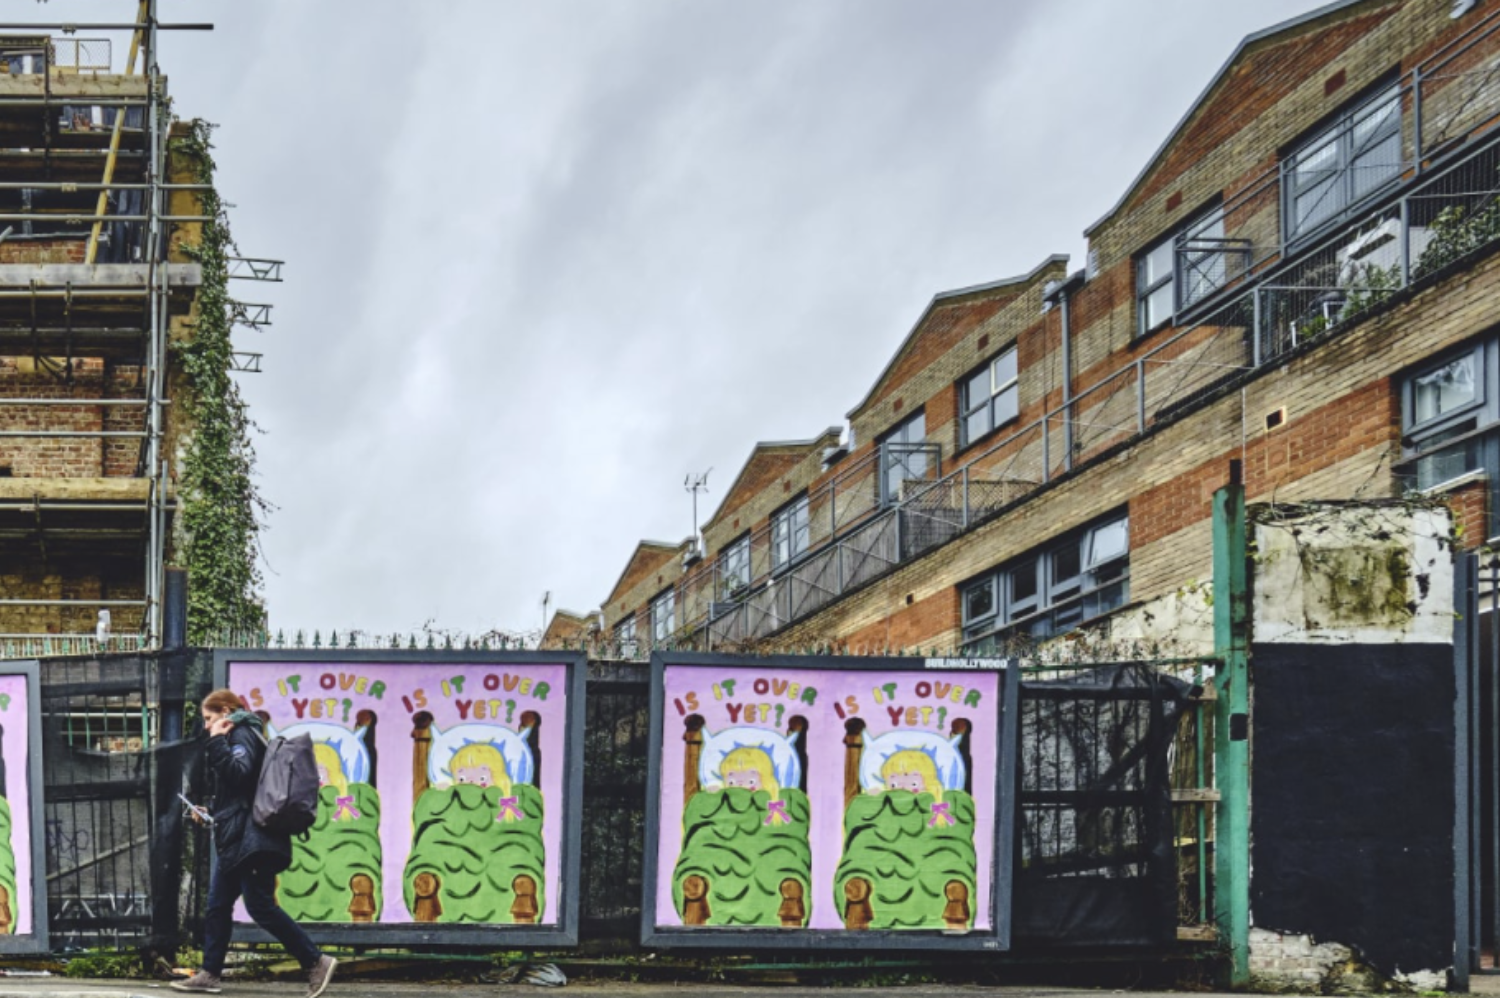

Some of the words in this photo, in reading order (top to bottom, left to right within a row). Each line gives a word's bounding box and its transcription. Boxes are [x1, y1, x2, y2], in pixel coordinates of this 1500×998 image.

[277, 674, 302, 697] IT
[320, 672, 387, 700] OVER
[402, 688, 428, 714] IS
[441, 675, 466, 698] IT
[483, 673, 551, 701] OVER
[674, 691, 699, 716] IS
[712, 678, 736, 701] IT
[753, 677, 818, 707] OVER
[291, 698, 353, 722] YET?
[455, 699, 517, 724] YET?
[834, 695, 859, 720] IS
[872, 682, 898, 705] IT
[915, 680, 982, 709] OVER
[726, 702, 786, 728] YET?
[887, 706, 948, 731] YET?
